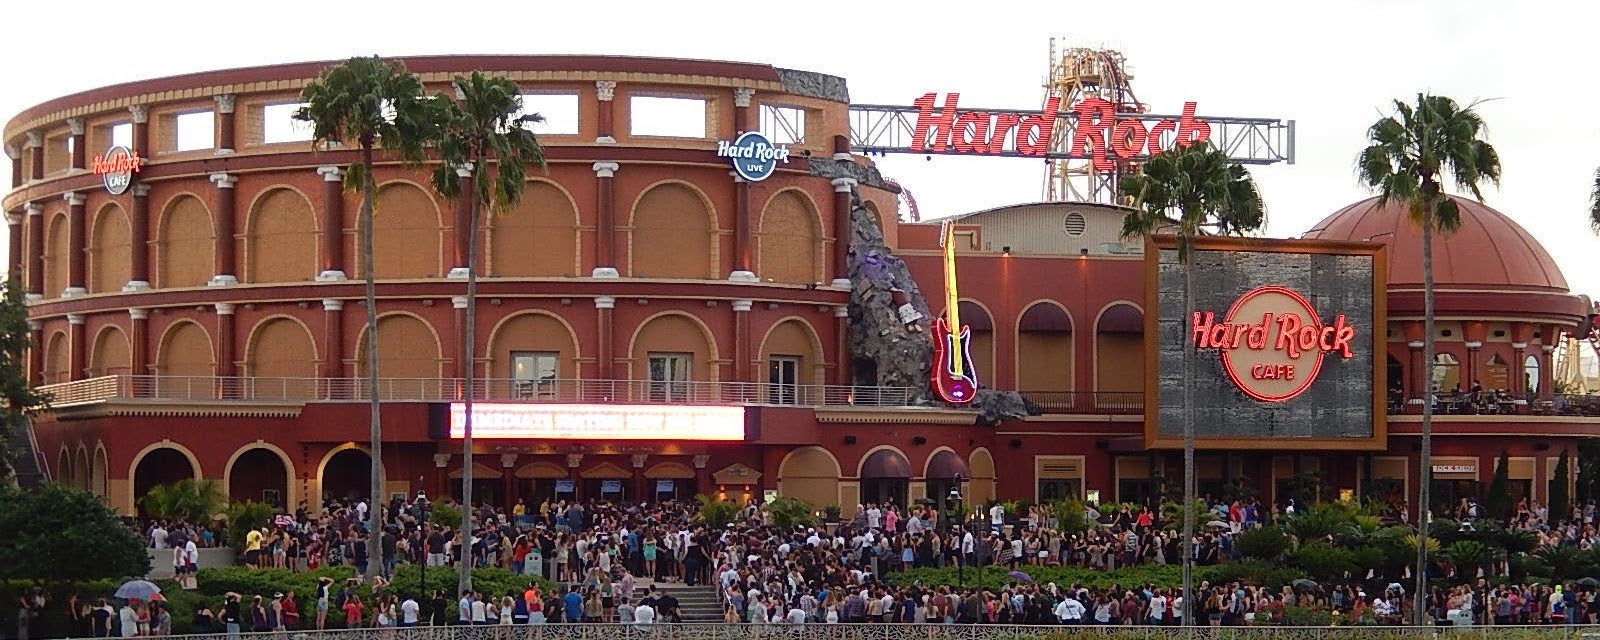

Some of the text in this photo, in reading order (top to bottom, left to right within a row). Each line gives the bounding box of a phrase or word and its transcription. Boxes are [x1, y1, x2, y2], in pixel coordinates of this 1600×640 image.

[910, 92, 1211, 172] Hard Rock
[94, 151, 140, 174] Hard Rock
[718, 140, 790, 163] Hard Rock
[109, 175, 126, 187] CAFE
[1193, 312, 1354, 359] Hard Rock
[1252, 364, 1295, 380] CAFE
